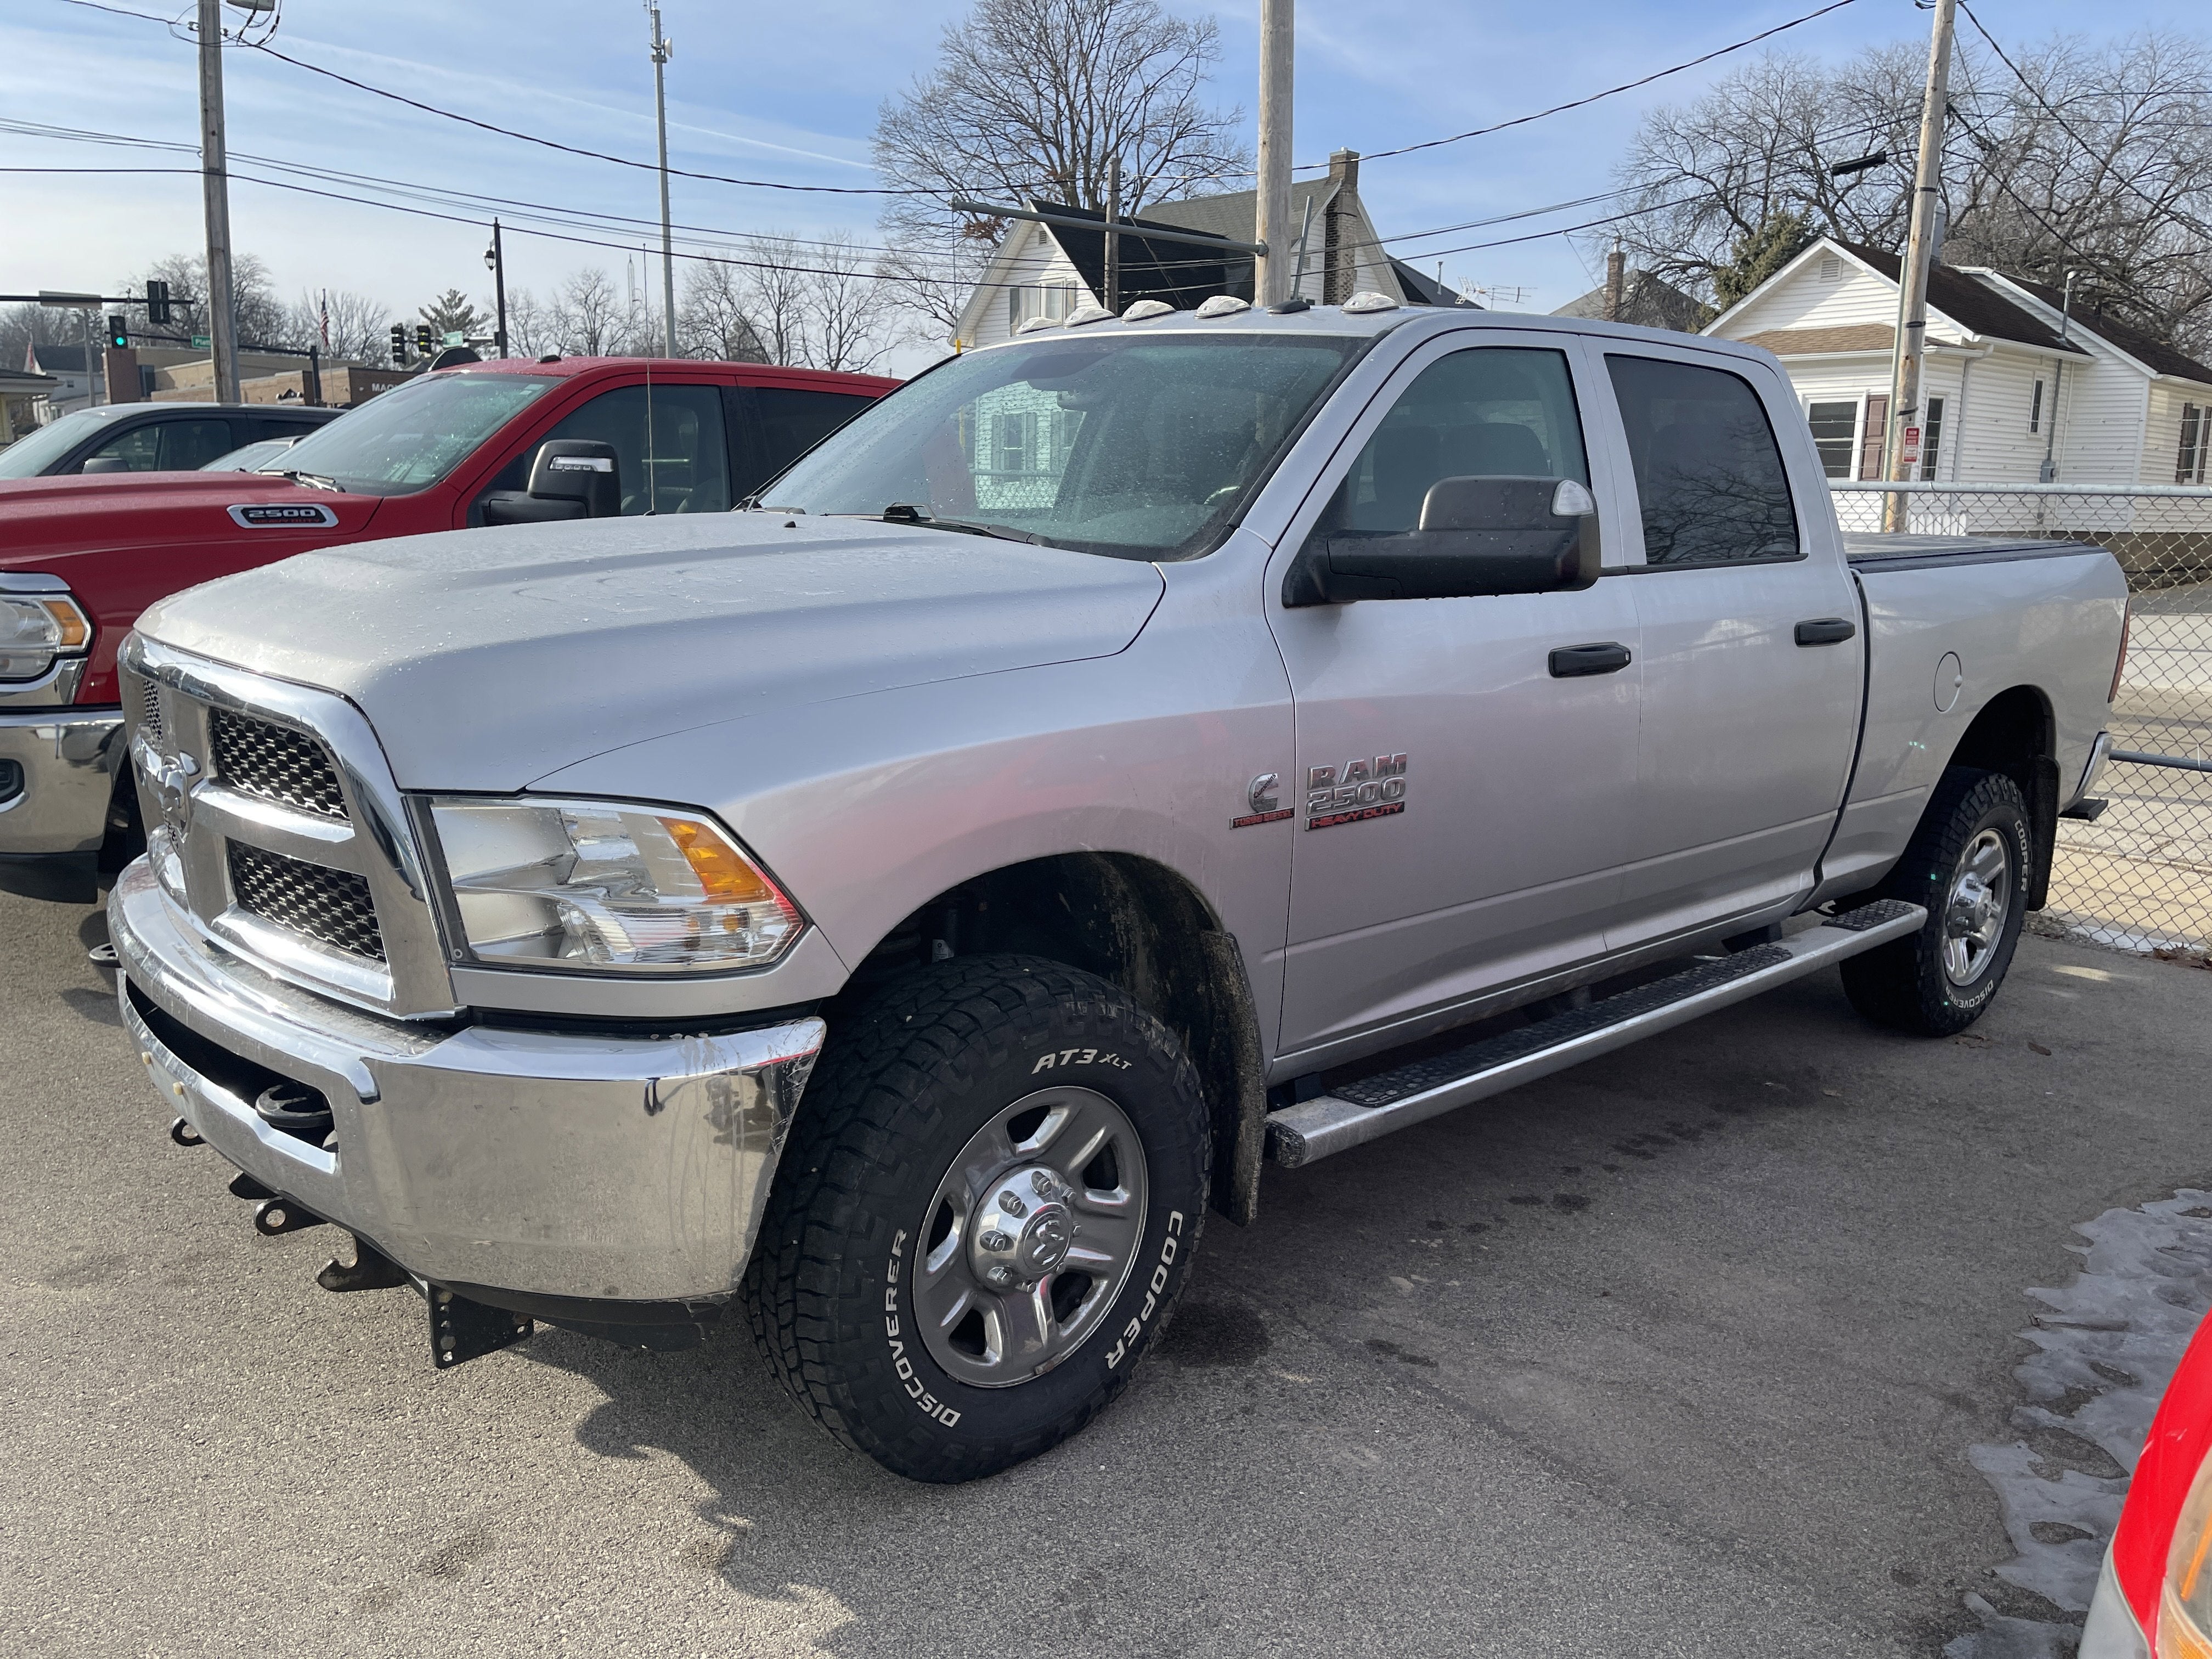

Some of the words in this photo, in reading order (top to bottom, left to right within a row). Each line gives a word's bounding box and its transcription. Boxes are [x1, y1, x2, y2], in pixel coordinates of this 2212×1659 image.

[249, 509, 317, 518] 2500
[1307, 752, 1407, 791] RAM
[1306, 776, 1406, 815] 2500
[1311, 810, 1362, 828] HEAVY
[1363, 803, 1402, 819] DUTY
[2014, 819, 2028, 891] COOPER
[1945, 979, 1994, 1008] DISCOVERER
[1031, 1048, 1098, 1075] AT3
[1098, 1053, 1132, 1070] XLT
[1104, 1210, 1183, 1369] COOPER
[885, 1228, 961, 1427] DISCOVERER
